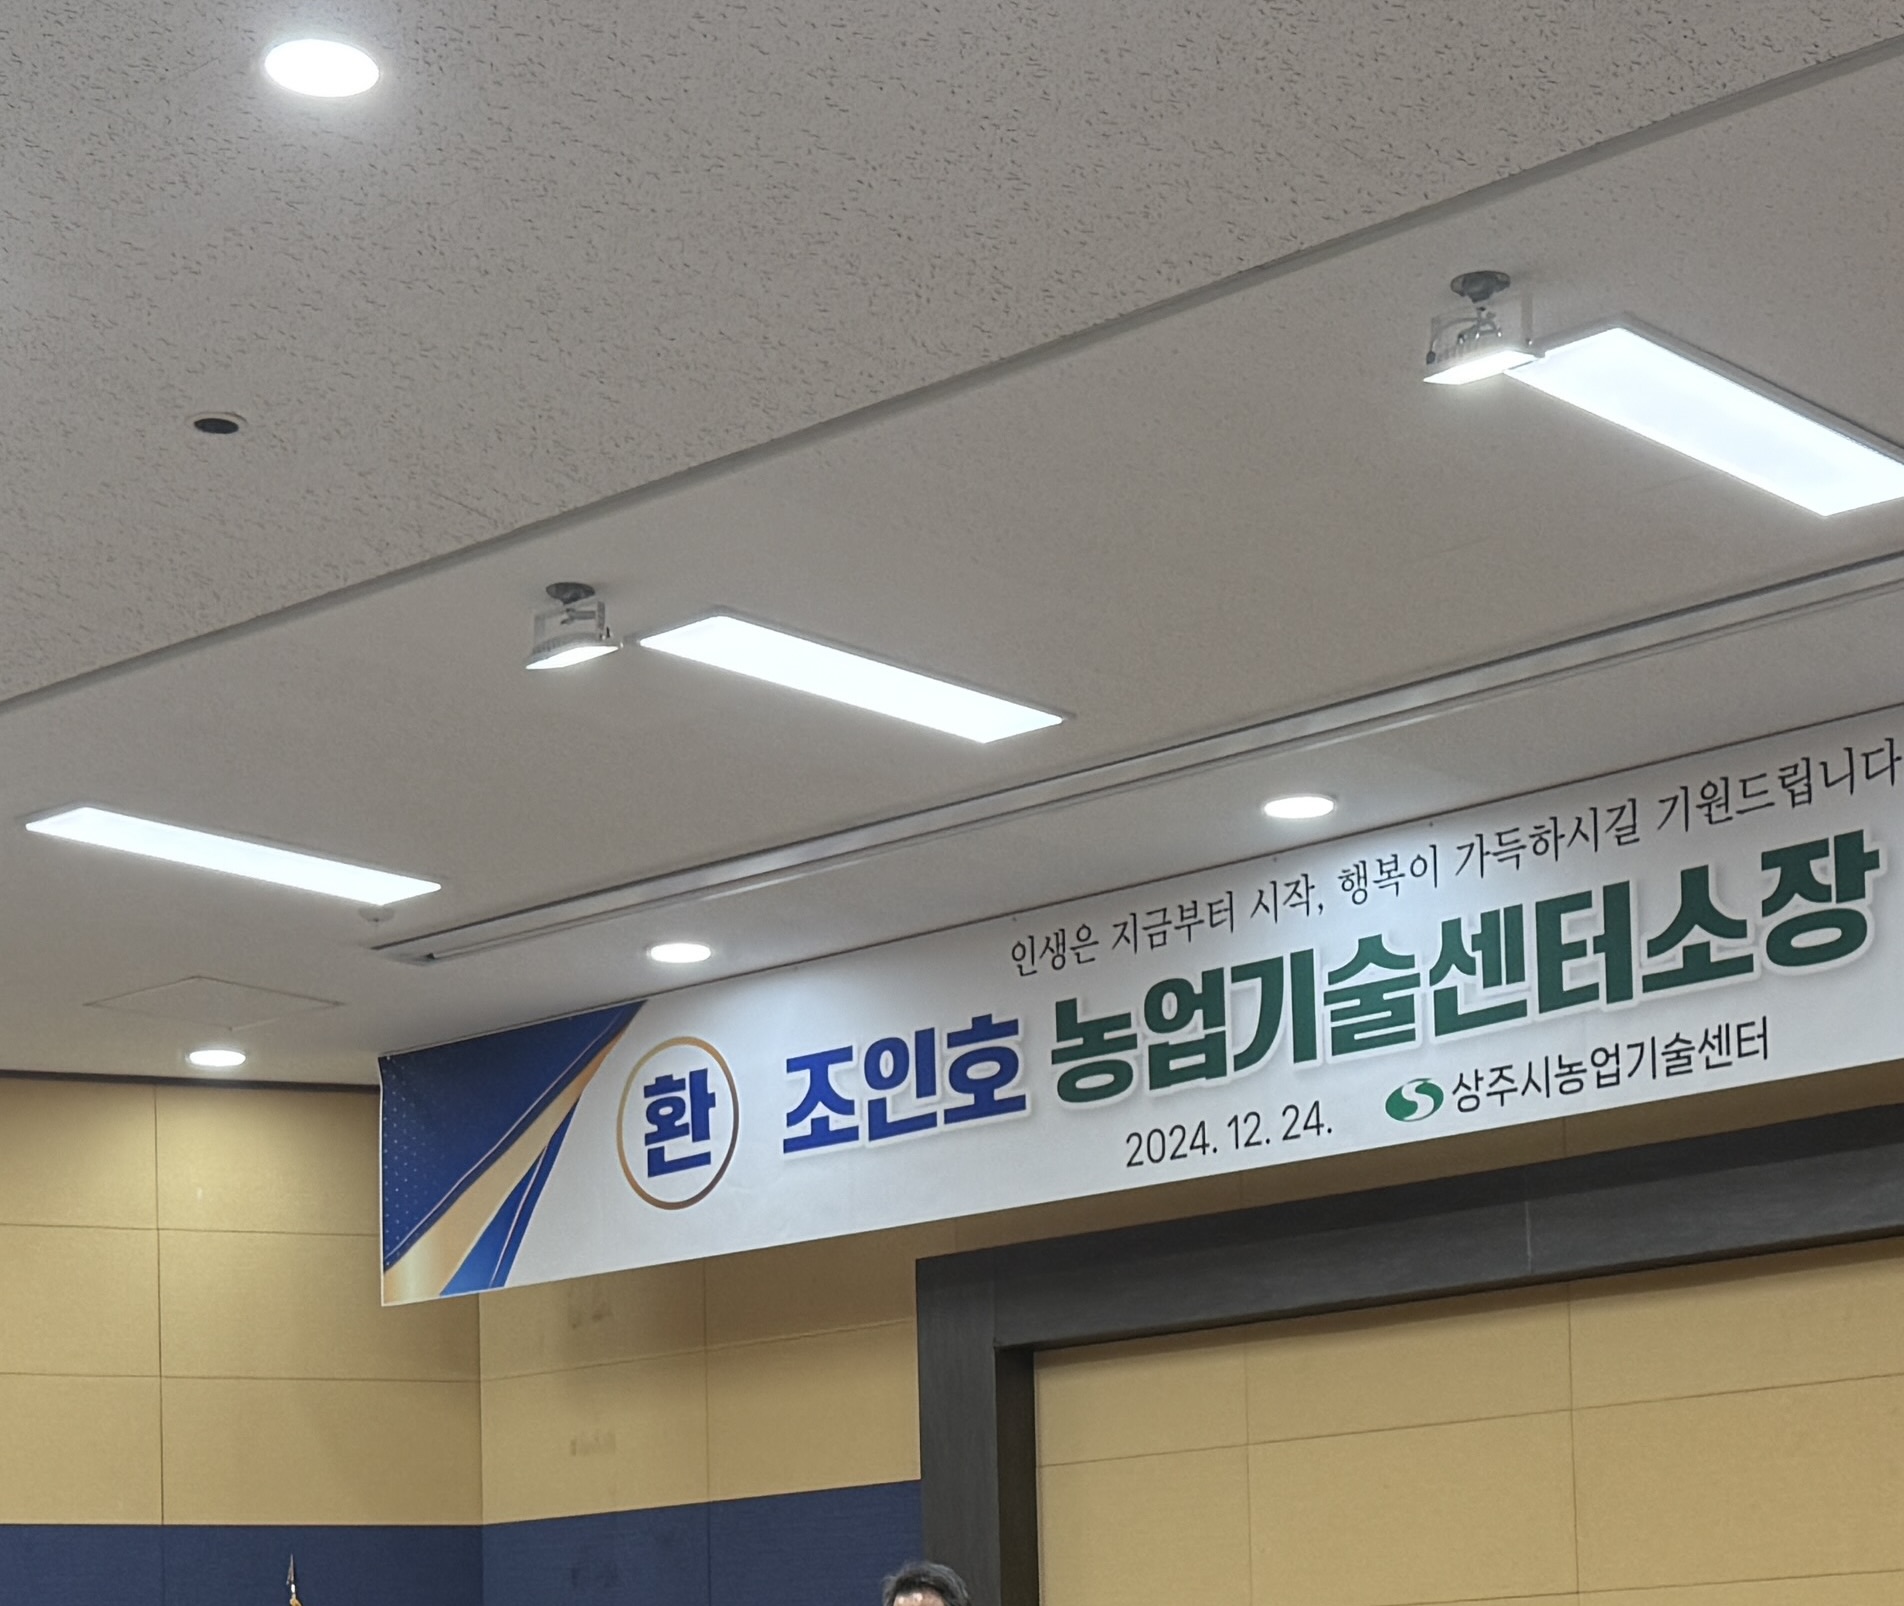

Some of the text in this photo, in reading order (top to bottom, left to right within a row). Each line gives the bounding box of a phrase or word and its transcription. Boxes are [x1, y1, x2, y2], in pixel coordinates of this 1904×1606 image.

[1010, 922, 1101, 977] 인생은
[1111, 890, 1236, 955] 지금부터
[1249, 872, 1325, 924] 시작,
[1337, 842, 1440, 906] 행복이
[1454, 797, 1641, 879] 가득하시길
[782, 1013, 1027, 1154] 조인호
[1050, 828, 1881, 1104] 농업기술센터소장
[1451, 1016, 1770, 1114] 상주시농업기술센터
[642, 1067, 716, 1178] 환
[1125, 1100, 1333, 1168] 2024. 12. 24.
